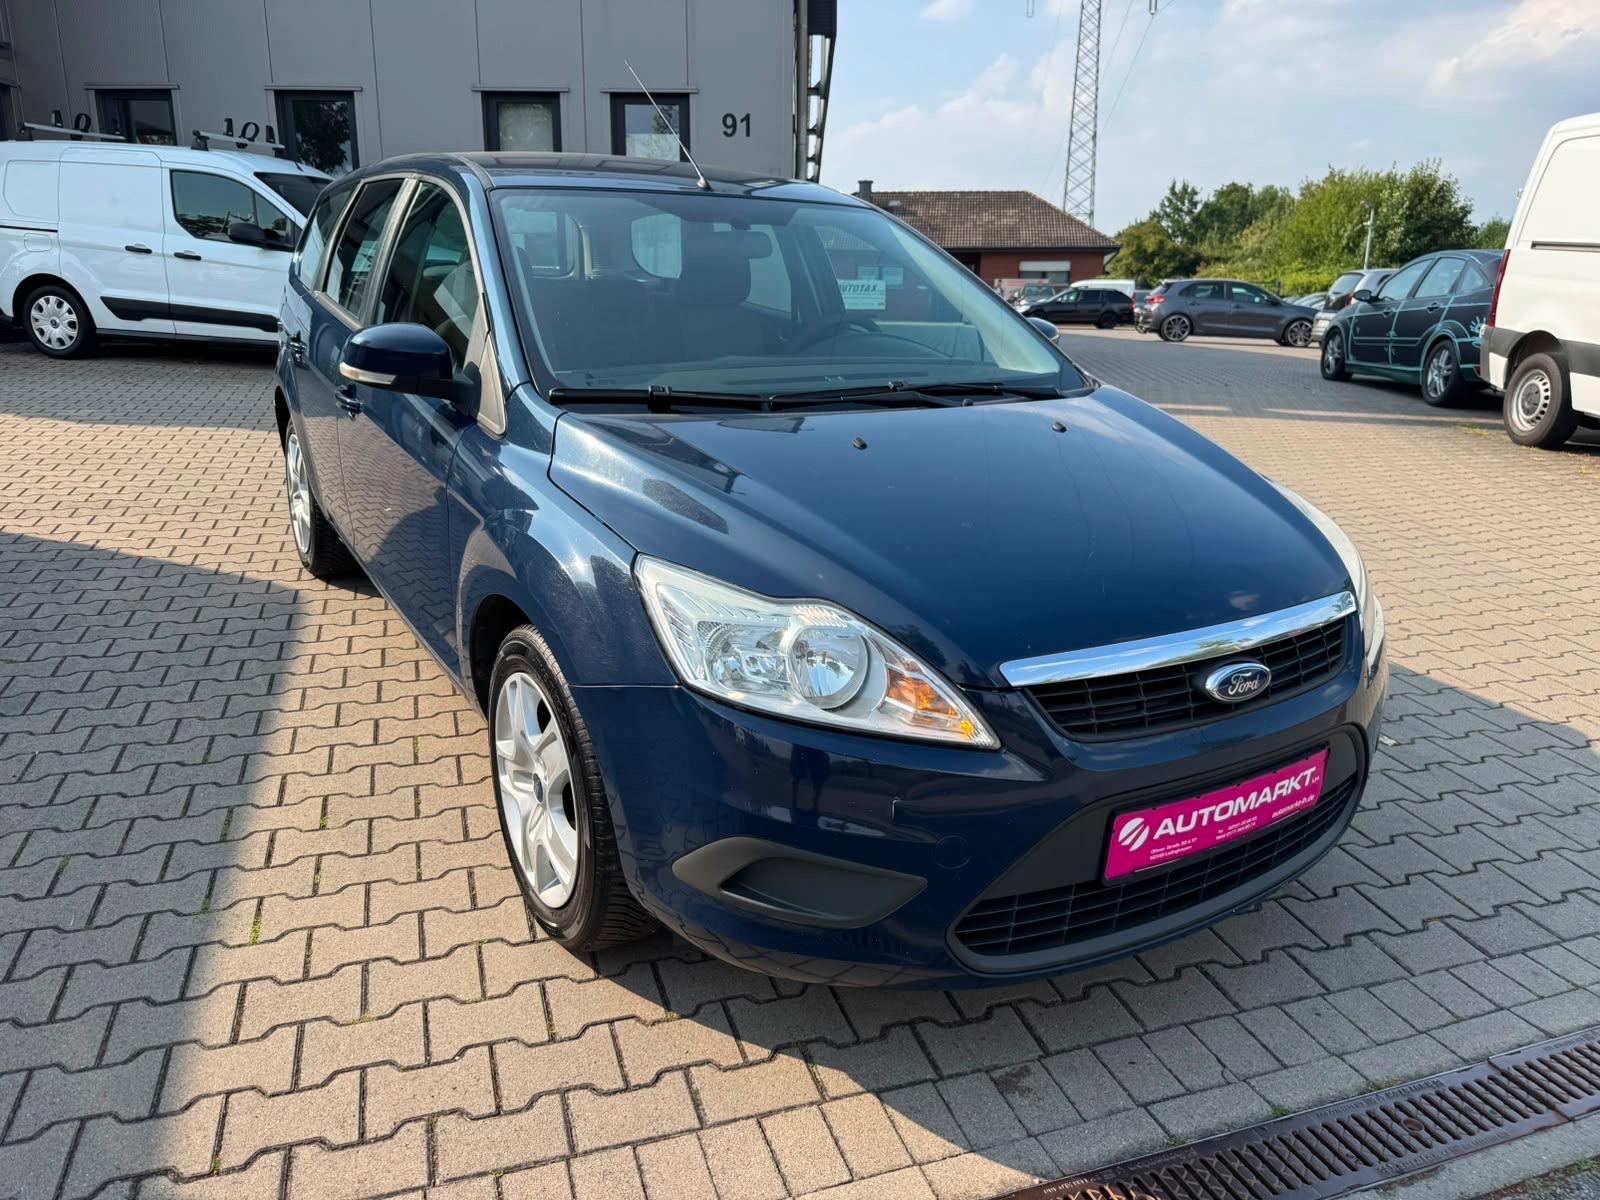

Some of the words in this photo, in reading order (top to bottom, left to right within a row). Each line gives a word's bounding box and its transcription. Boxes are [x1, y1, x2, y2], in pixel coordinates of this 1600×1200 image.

[722, 112, 751, 138] 91
[1228, 672, 1260, 695] Ford
[1153, 766, 1316, 840] AUTOMARKT
